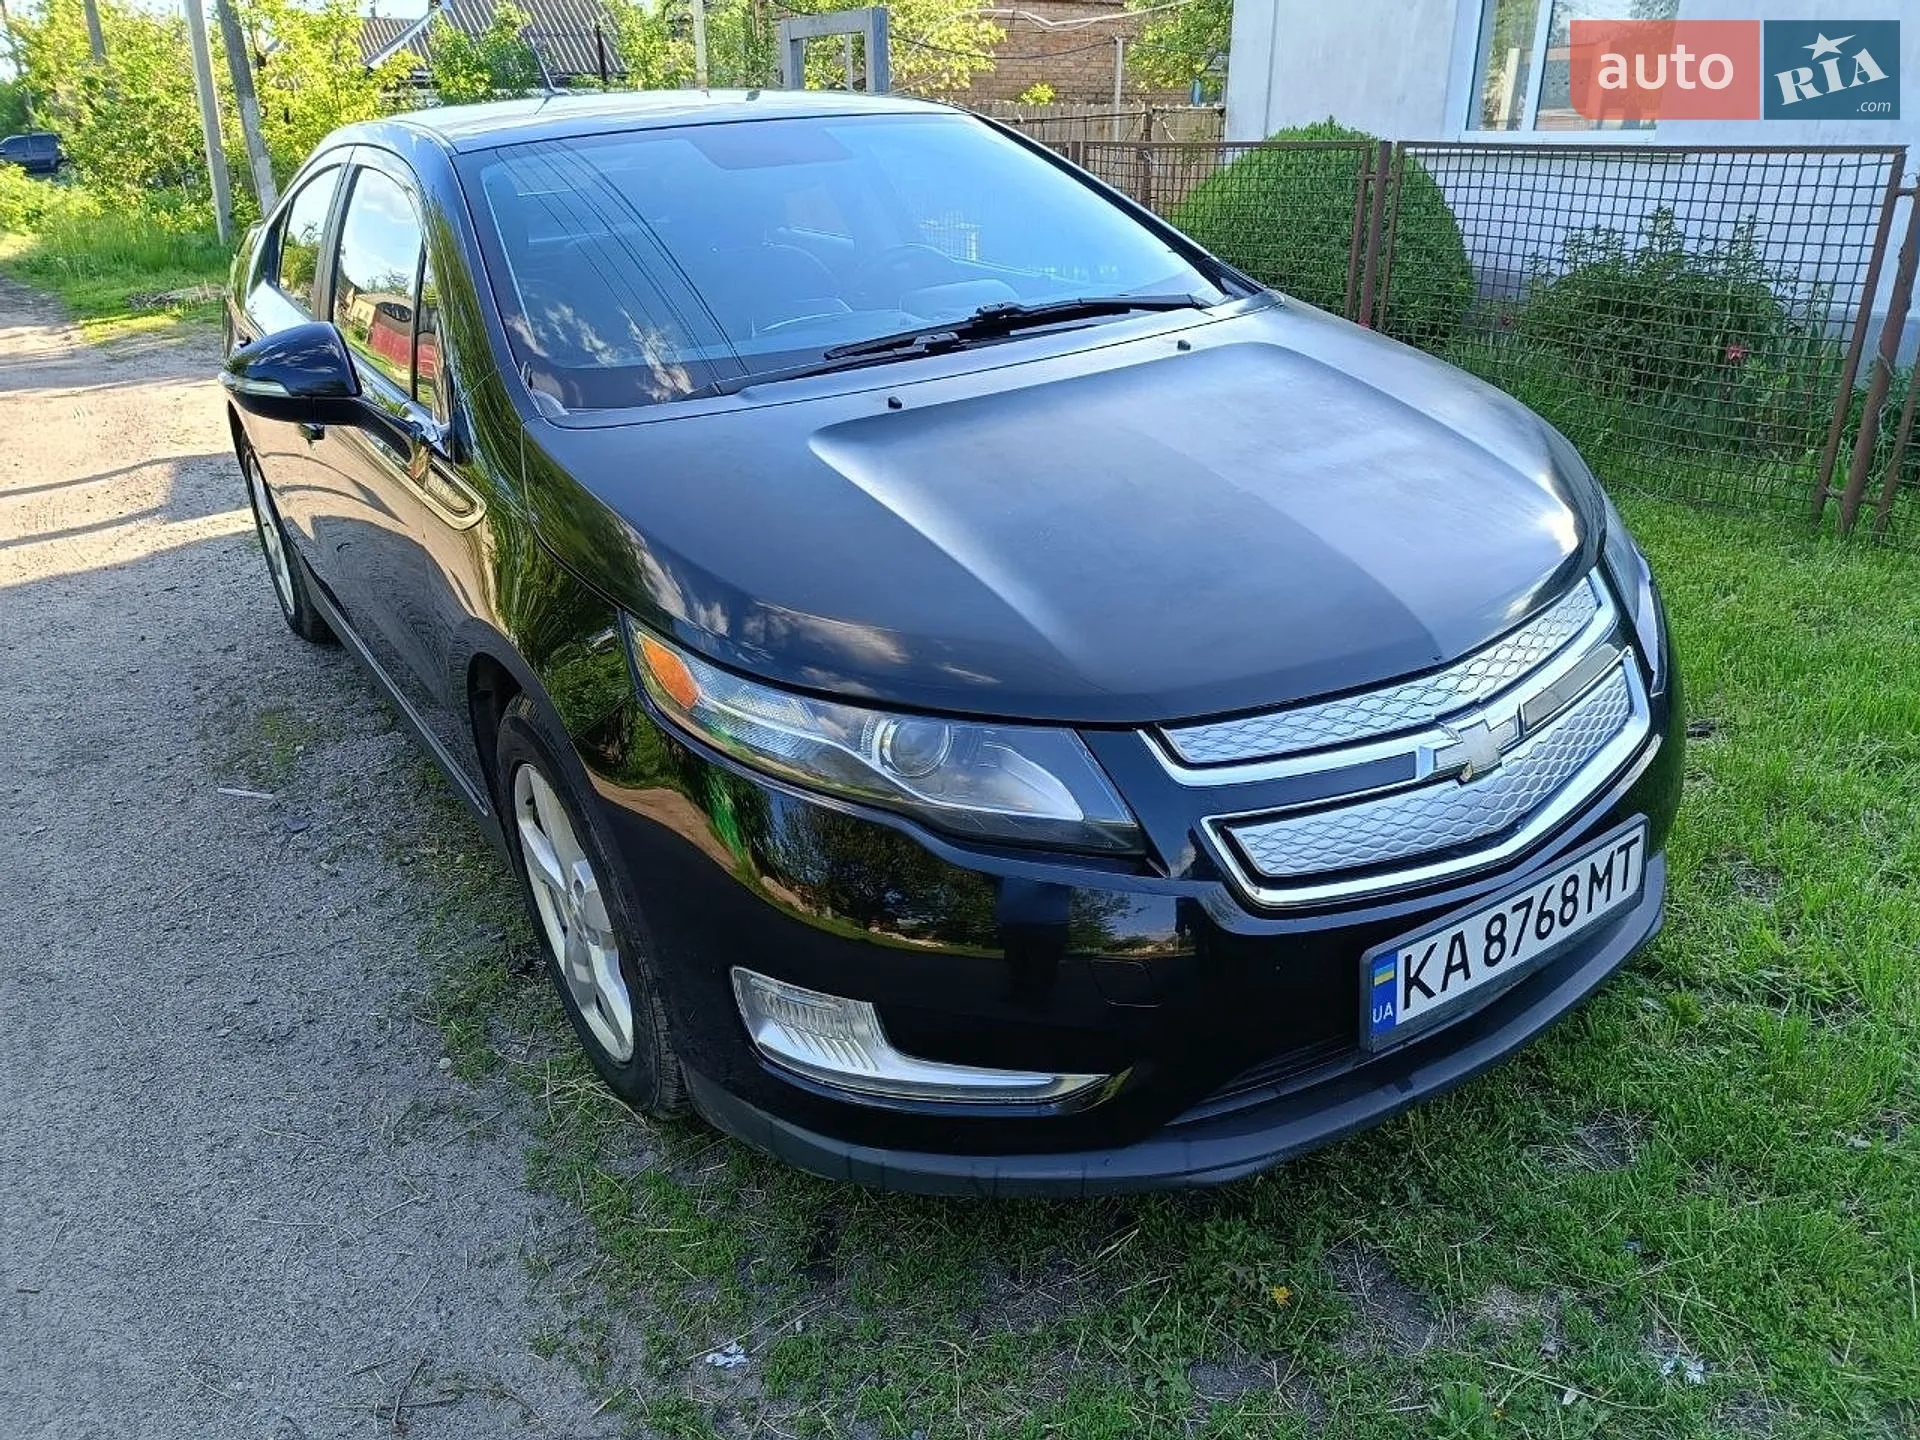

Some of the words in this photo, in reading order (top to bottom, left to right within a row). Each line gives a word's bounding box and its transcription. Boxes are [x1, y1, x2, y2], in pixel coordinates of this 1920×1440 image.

[1402, 930, 1471, 1010] KA
[1483, 873, 1580, 967] 8768
[1587, 834, 1641, 914] MT
[1372, 1001, 1394, 1023] UA
